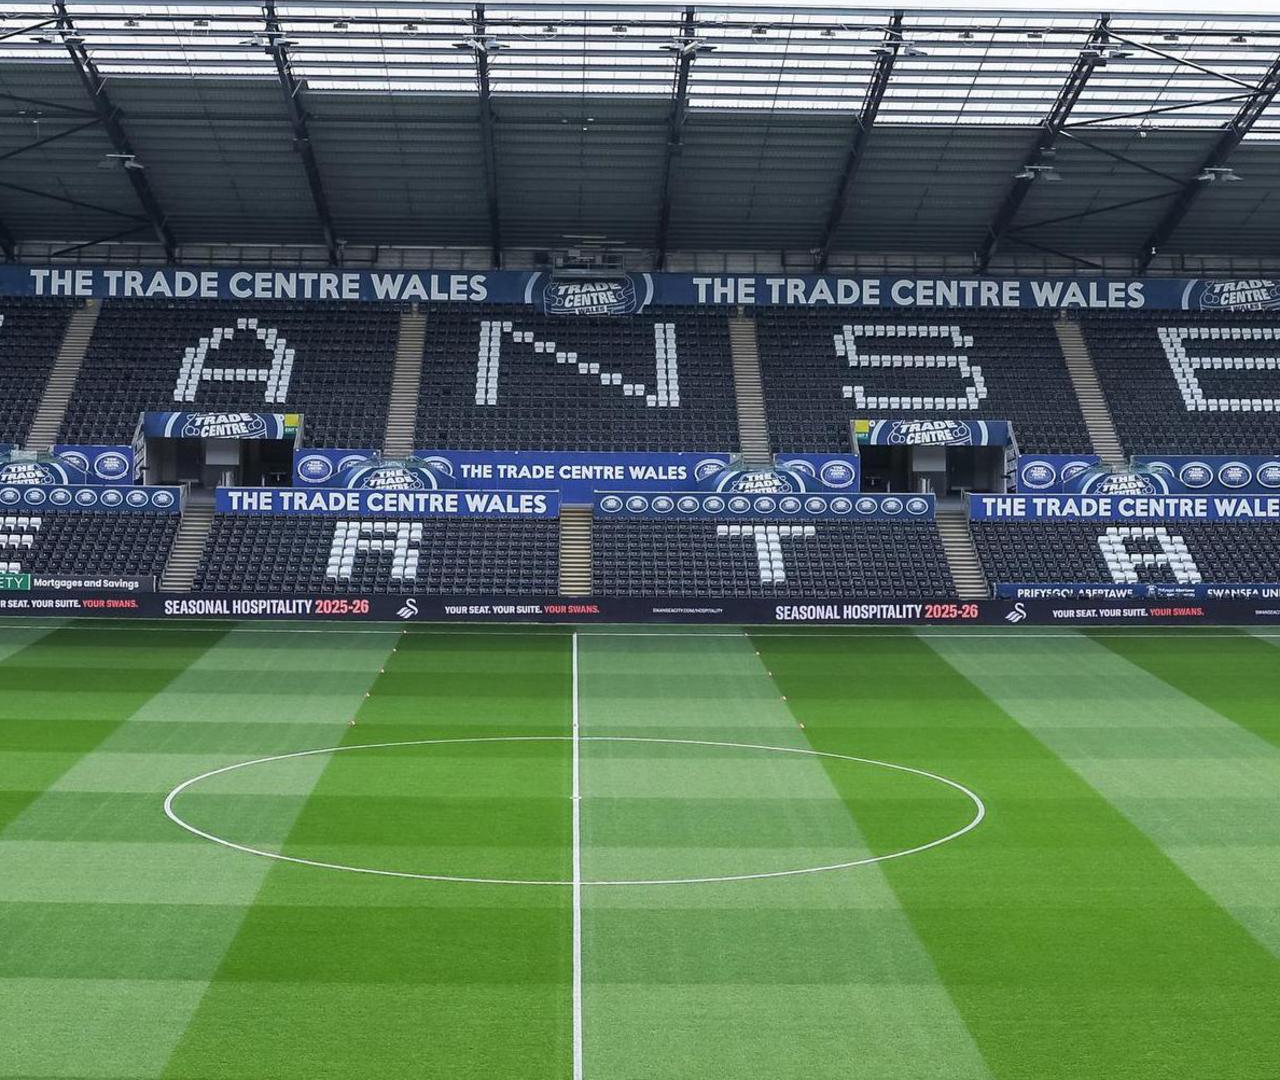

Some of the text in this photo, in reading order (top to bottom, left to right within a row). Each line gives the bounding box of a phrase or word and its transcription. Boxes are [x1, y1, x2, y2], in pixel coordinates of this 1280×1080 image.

[31, 270, 487, 301] THE TRADE CENTRE WALES
[557, 280, 620, 295] TRADE
[693, 278, 1145, 308] THE TRADE CENTRE WALES
[1213, 280, 1275, 293] TRADE
[565, 291, 617, 307] CENTRE
[1220, 288, 1271, 305] CENTRE
[195, 412, 253, 426] TRADE
[900, 420, 957, 433] TRADE
[201, 422, 250, 437] CENTRE
[907, 430, 953, 444] CENTRE
[461, 464, 687, 480] THE TRADE CENTRE WALES
[228, 491, 547, 513] THE TRADE CENTRE WALES
[983, 497, 1026, 516] THE
[1033, 498, 1111, 516] TRADE
[1118, 498, 1207, 517] CENTRE
[34, 578, 139, 591] Mortgages and Savings
[7, 600, 29, 608] SEAT.
[31, 600, 53, 608] YOUR
[55, 600, 81, 608] SUITE.
[83, 600, 104, 608] YOUR
[106, 600, 138, 608] SWANS.
[165, 599, 369, 614] SEASONAL HOSPITALITY 2025-26
[445, 605, 600, 614] YOUR SEAT. YOUR SUITE. YOUR SWANS.
[776, 604, 978, 620] SEASONAL HOSPITALITY 2025-26
[1053, 607, 1204, 618] YOUR SEAT. YOUR SUITE. YOUR SWANS.
